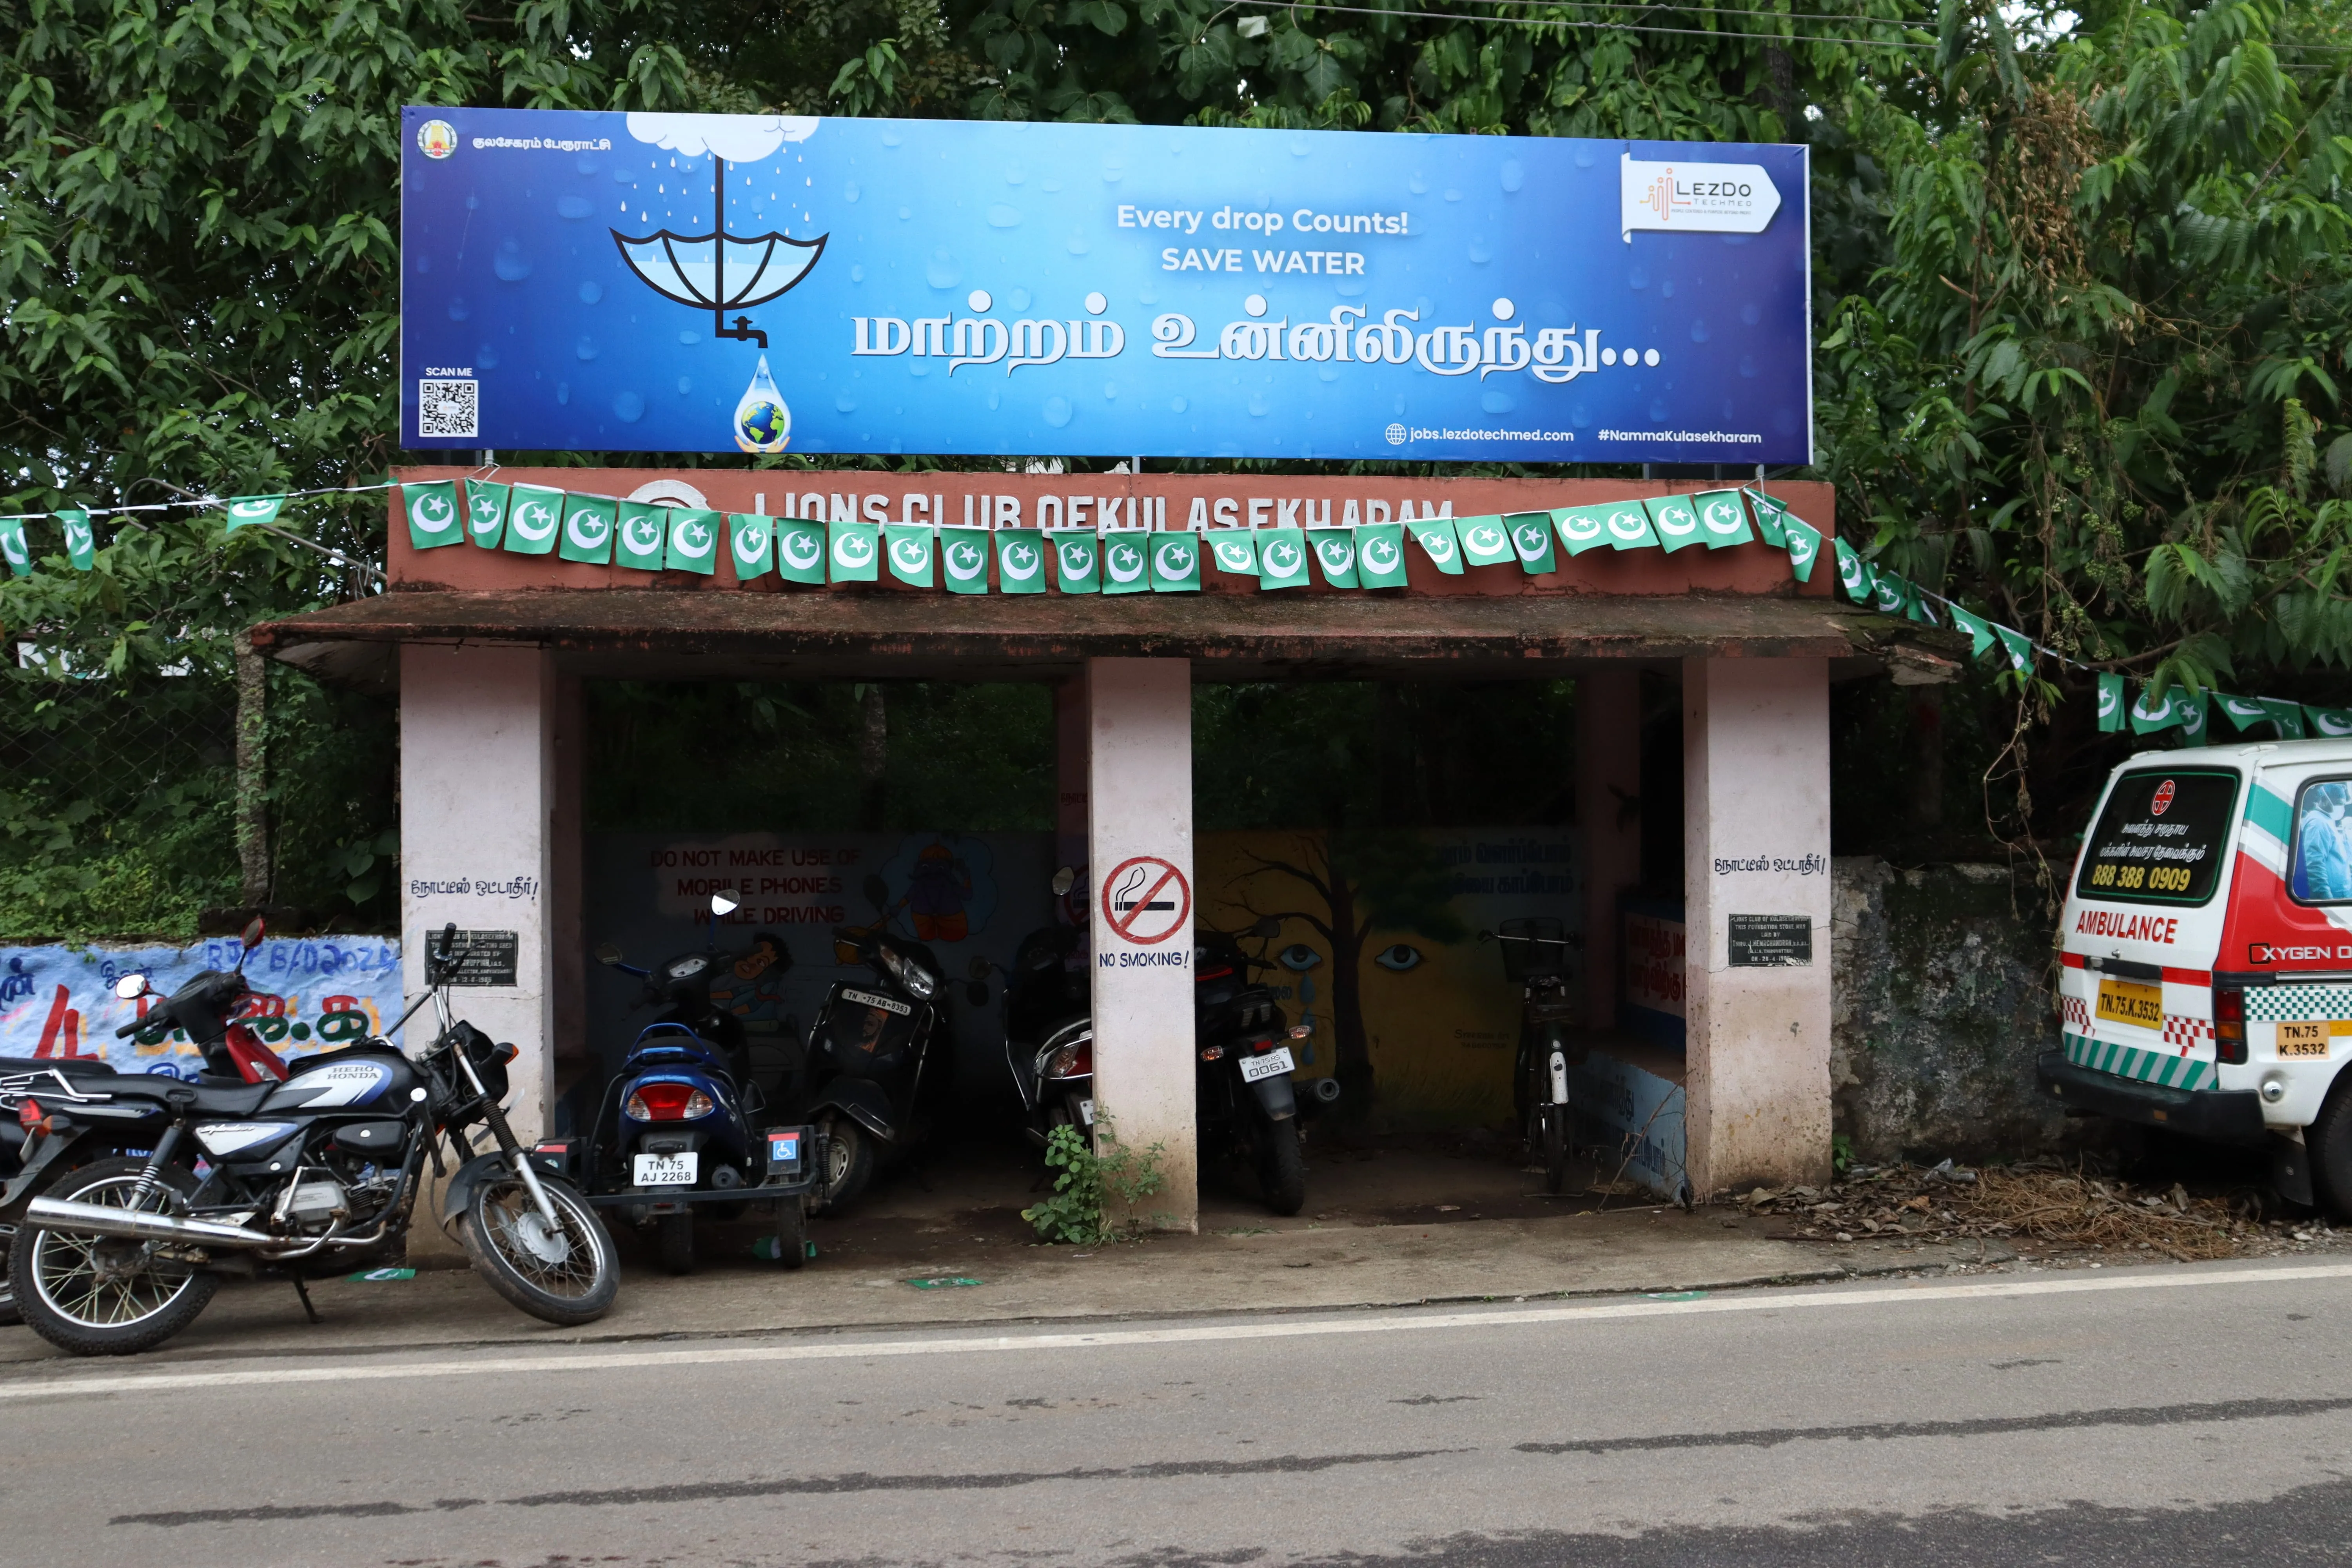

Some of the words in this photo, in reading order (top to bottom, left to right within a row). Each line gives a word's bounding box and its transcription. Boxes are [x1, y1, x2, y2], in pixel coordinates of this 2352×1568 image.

[1694, 198, 1752, 207] TECHMED
[1118, 205, 1203, 235] Every
[1212, 206, 1283, 236] drop
[1292, 209, 1408, 234] Counts!
[1162, 248, 1243, 271] SAVE
[1252, 250, 1365, 275] WATER
[850, 289, 1125, 378] மாற்றம்
[425, 367, 455, 376] SCAN
[457, 368, 472, 377] ME
[1410, 427, 1574, 443] jobs.lezdotechmed.com
[1598, 429, 1762, 444] #NammaKulasekharam
[651, 851, 676, 867] DO
[683, 851, 721, 867] NOT
[730, 850, 784, 866] MAKE
[792, 849, 831, 866] USE
[837, 849, 861, 865] OF
[760, 877, 842, 894] PHONES
[2092, 864, 2117, 886] 888
[2116, 866, 2145, 889] 388
[2149, 867, 2191, 891] 0909
[764, 906, 846, 924] DRIVING
[2076, 910, 2179, 944] AMBULANCE
[1100, 953, 1114, 967] NO
[1120, 950, 1189, 969] SMOKING!
[848, 992, 858, 1000] TN
[2101, 993, 2160, 1022] TN.75.K.3532
[2284, 1025, 2318, 1038] TN.75
[2279, 1043, 2325, 1056] K.3532
[1249, 1061, 1288, 1077] 0061
[648, 1161, 664, 1170] TN
[670, 1160, 684, 1170] 75
[641, 1173, 657, 1182] AJ
[661, 1172, 691, 1181] 2268
